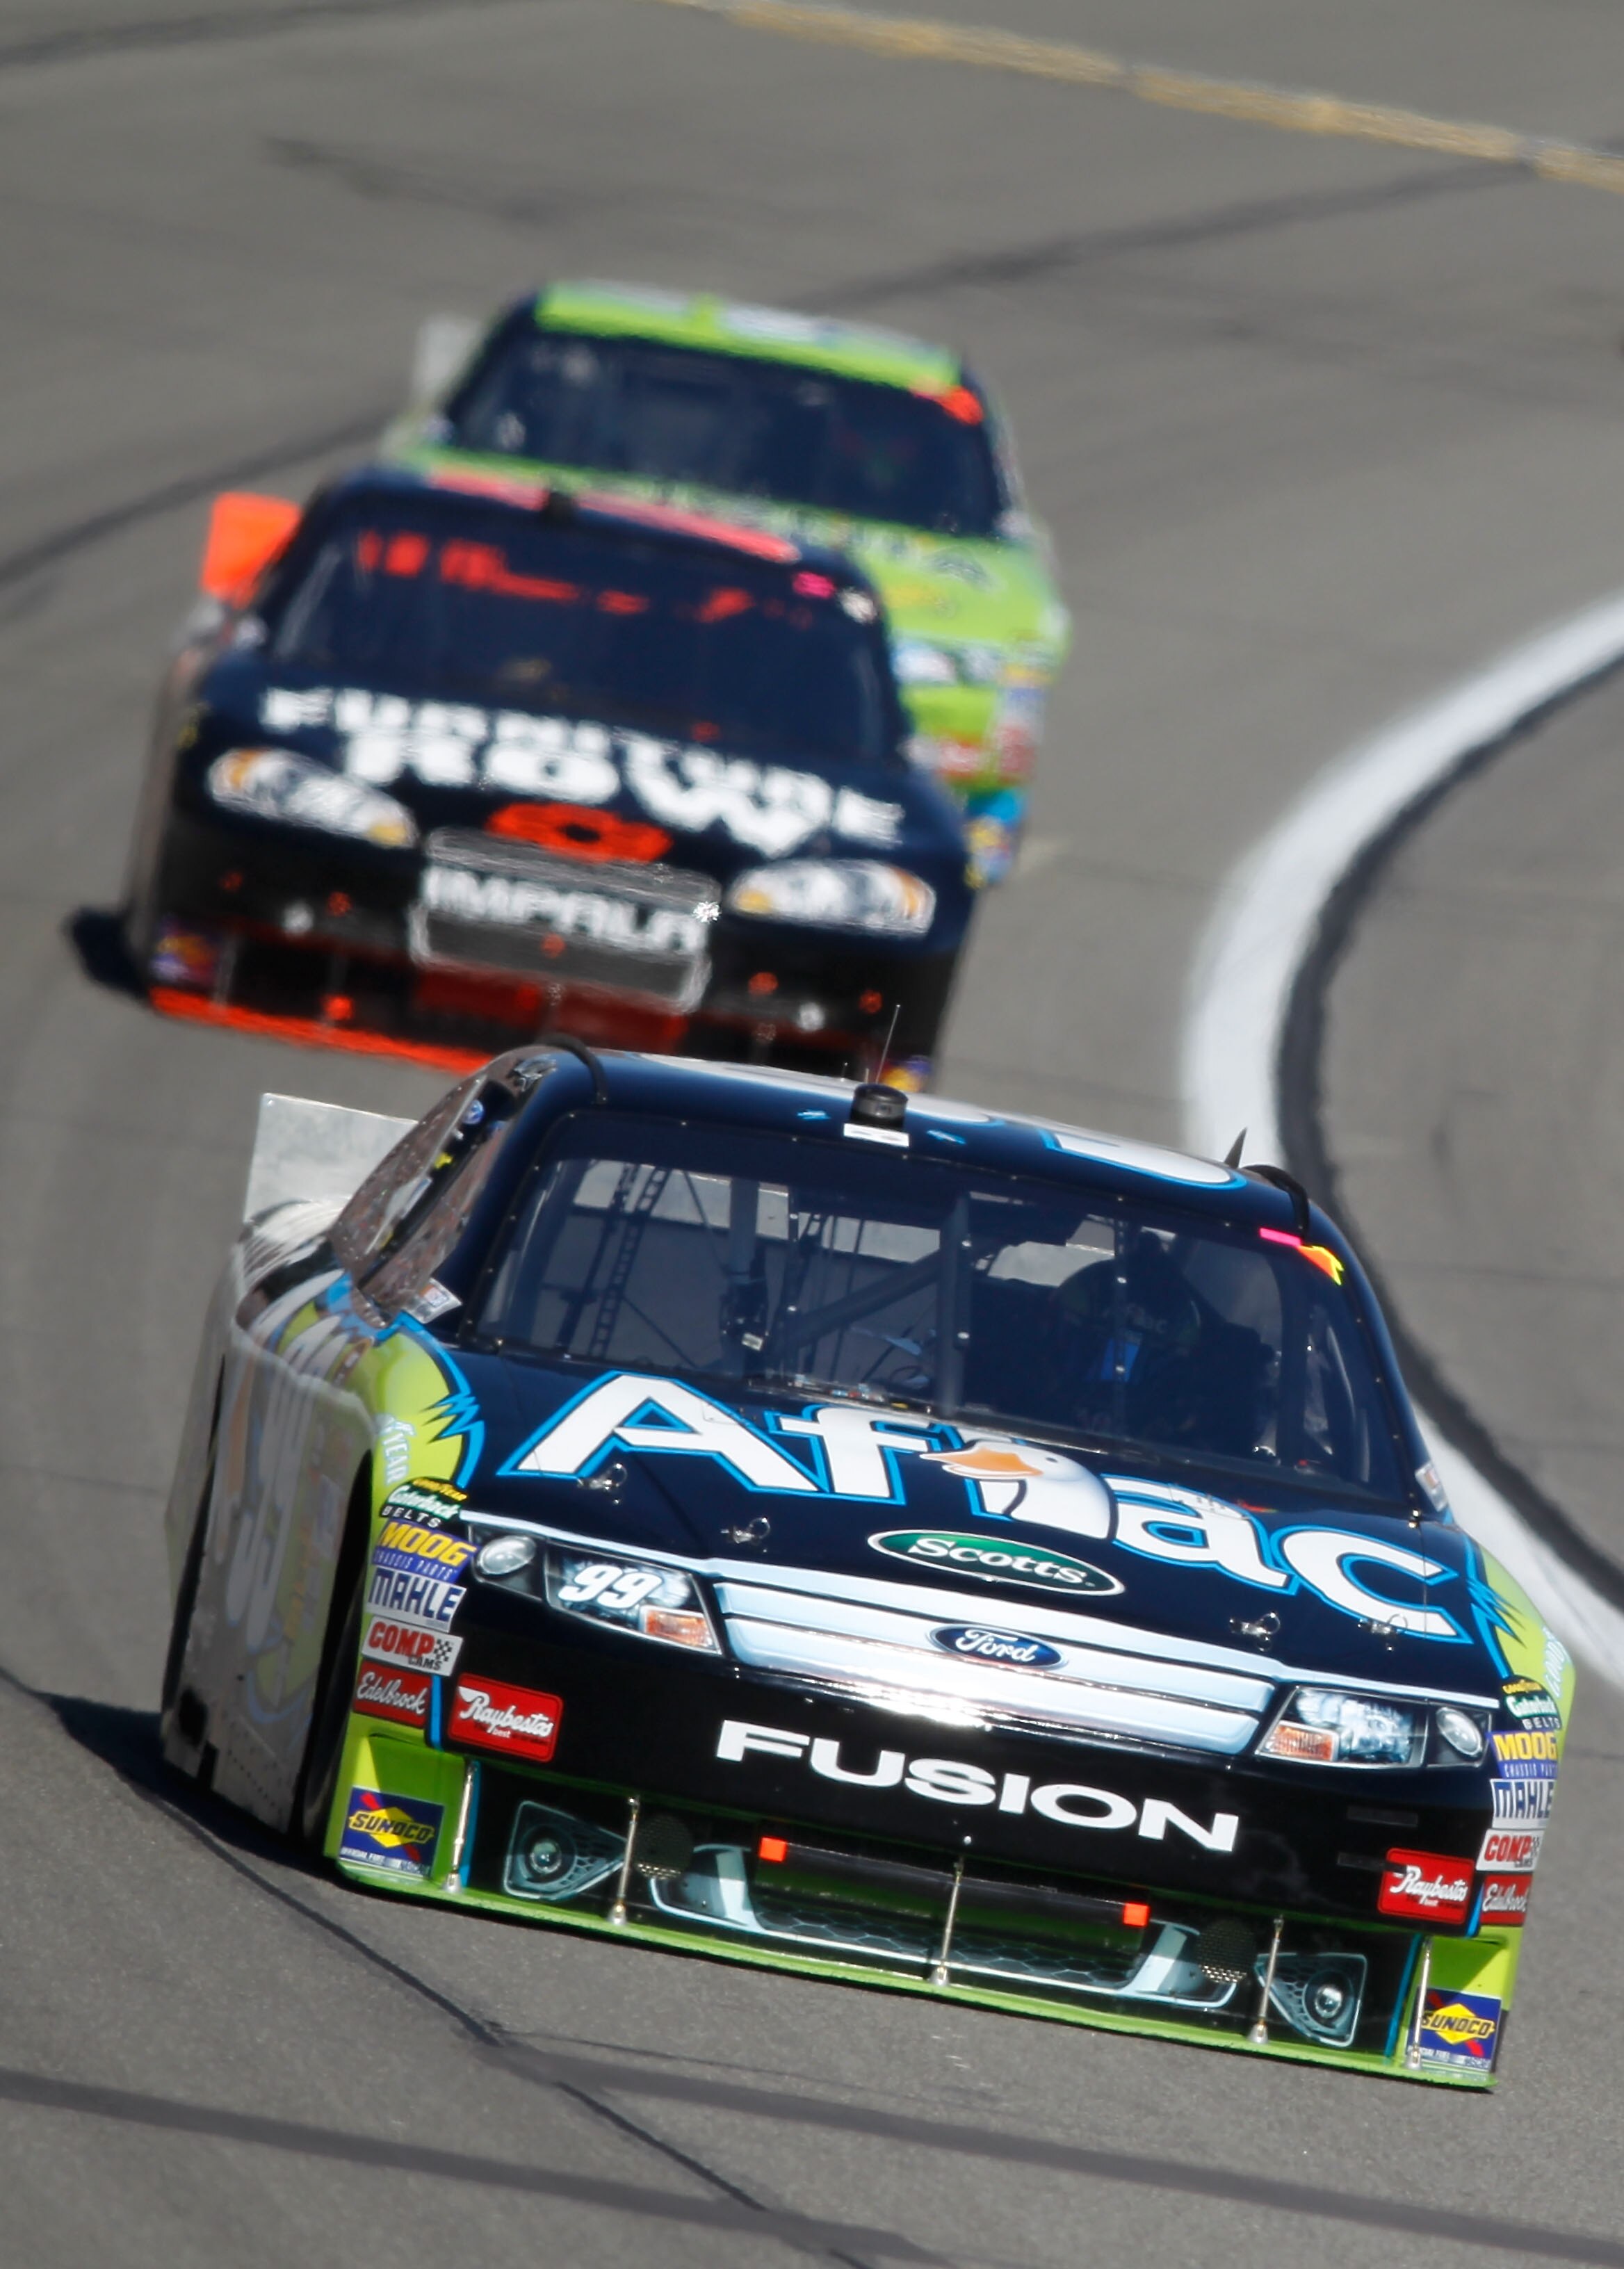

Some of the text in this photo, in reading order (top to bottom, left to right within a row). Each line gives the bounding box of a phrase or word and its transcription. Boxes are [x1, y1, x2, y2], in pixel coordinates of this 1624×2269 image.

[344, 730, 822, 858] ROW
[421, 862, 708, 952] IMPALA
[381, 1506, 441, 1528] BELTS
[381, 1522, 478, 1567] MOOG
[908, 1538, 1087, 1584] Scotts
[368, 1568, 464, 1623] MAHLE
[558, 1564, 663, 1609] 99
[368, 1621, 435, 1658] COMP
[955, 1628, 1037, 1663] Ford
[407, 1654, 443, 1671] CAMS
[357, 1671, 429, 1715] Edelbrock
[1522, 1717, 1561, 1730] BELTS
[1493, 1731, 1557, 1762] MOOG
[716, 1719, 1240, 1853] FUSION
[1495, 1781, 1554, 1819] MAHLE
[353, 1813, 431, 1841] SUNOCO
[1484, 1834, 1532, 1862] COMP
[1421, 2012, 1491, 2036] SUNOCO
